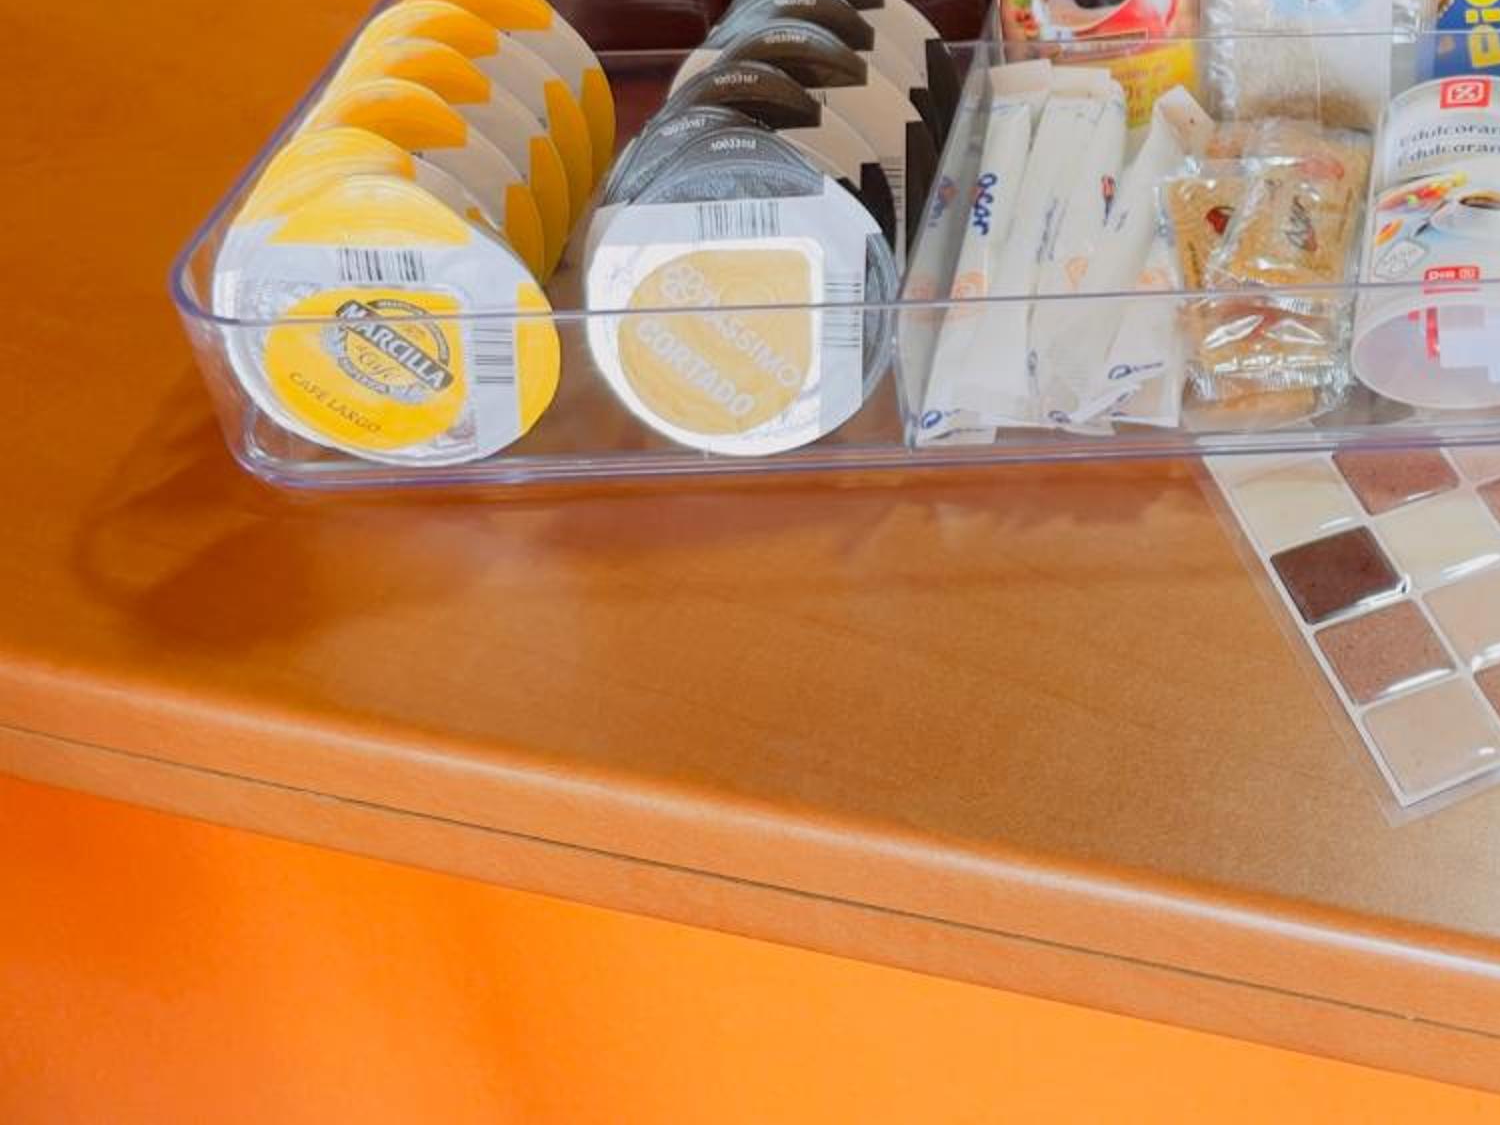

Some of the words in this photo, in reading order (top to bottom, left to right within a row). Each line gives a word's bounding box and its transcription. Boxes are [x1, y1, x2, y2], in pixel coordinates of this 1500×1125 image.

[339, 303, 446, 390] MARCILLA
[635, 315, 755, 417] CORTADO
[696, 283, 801, 387] TASSIMO
